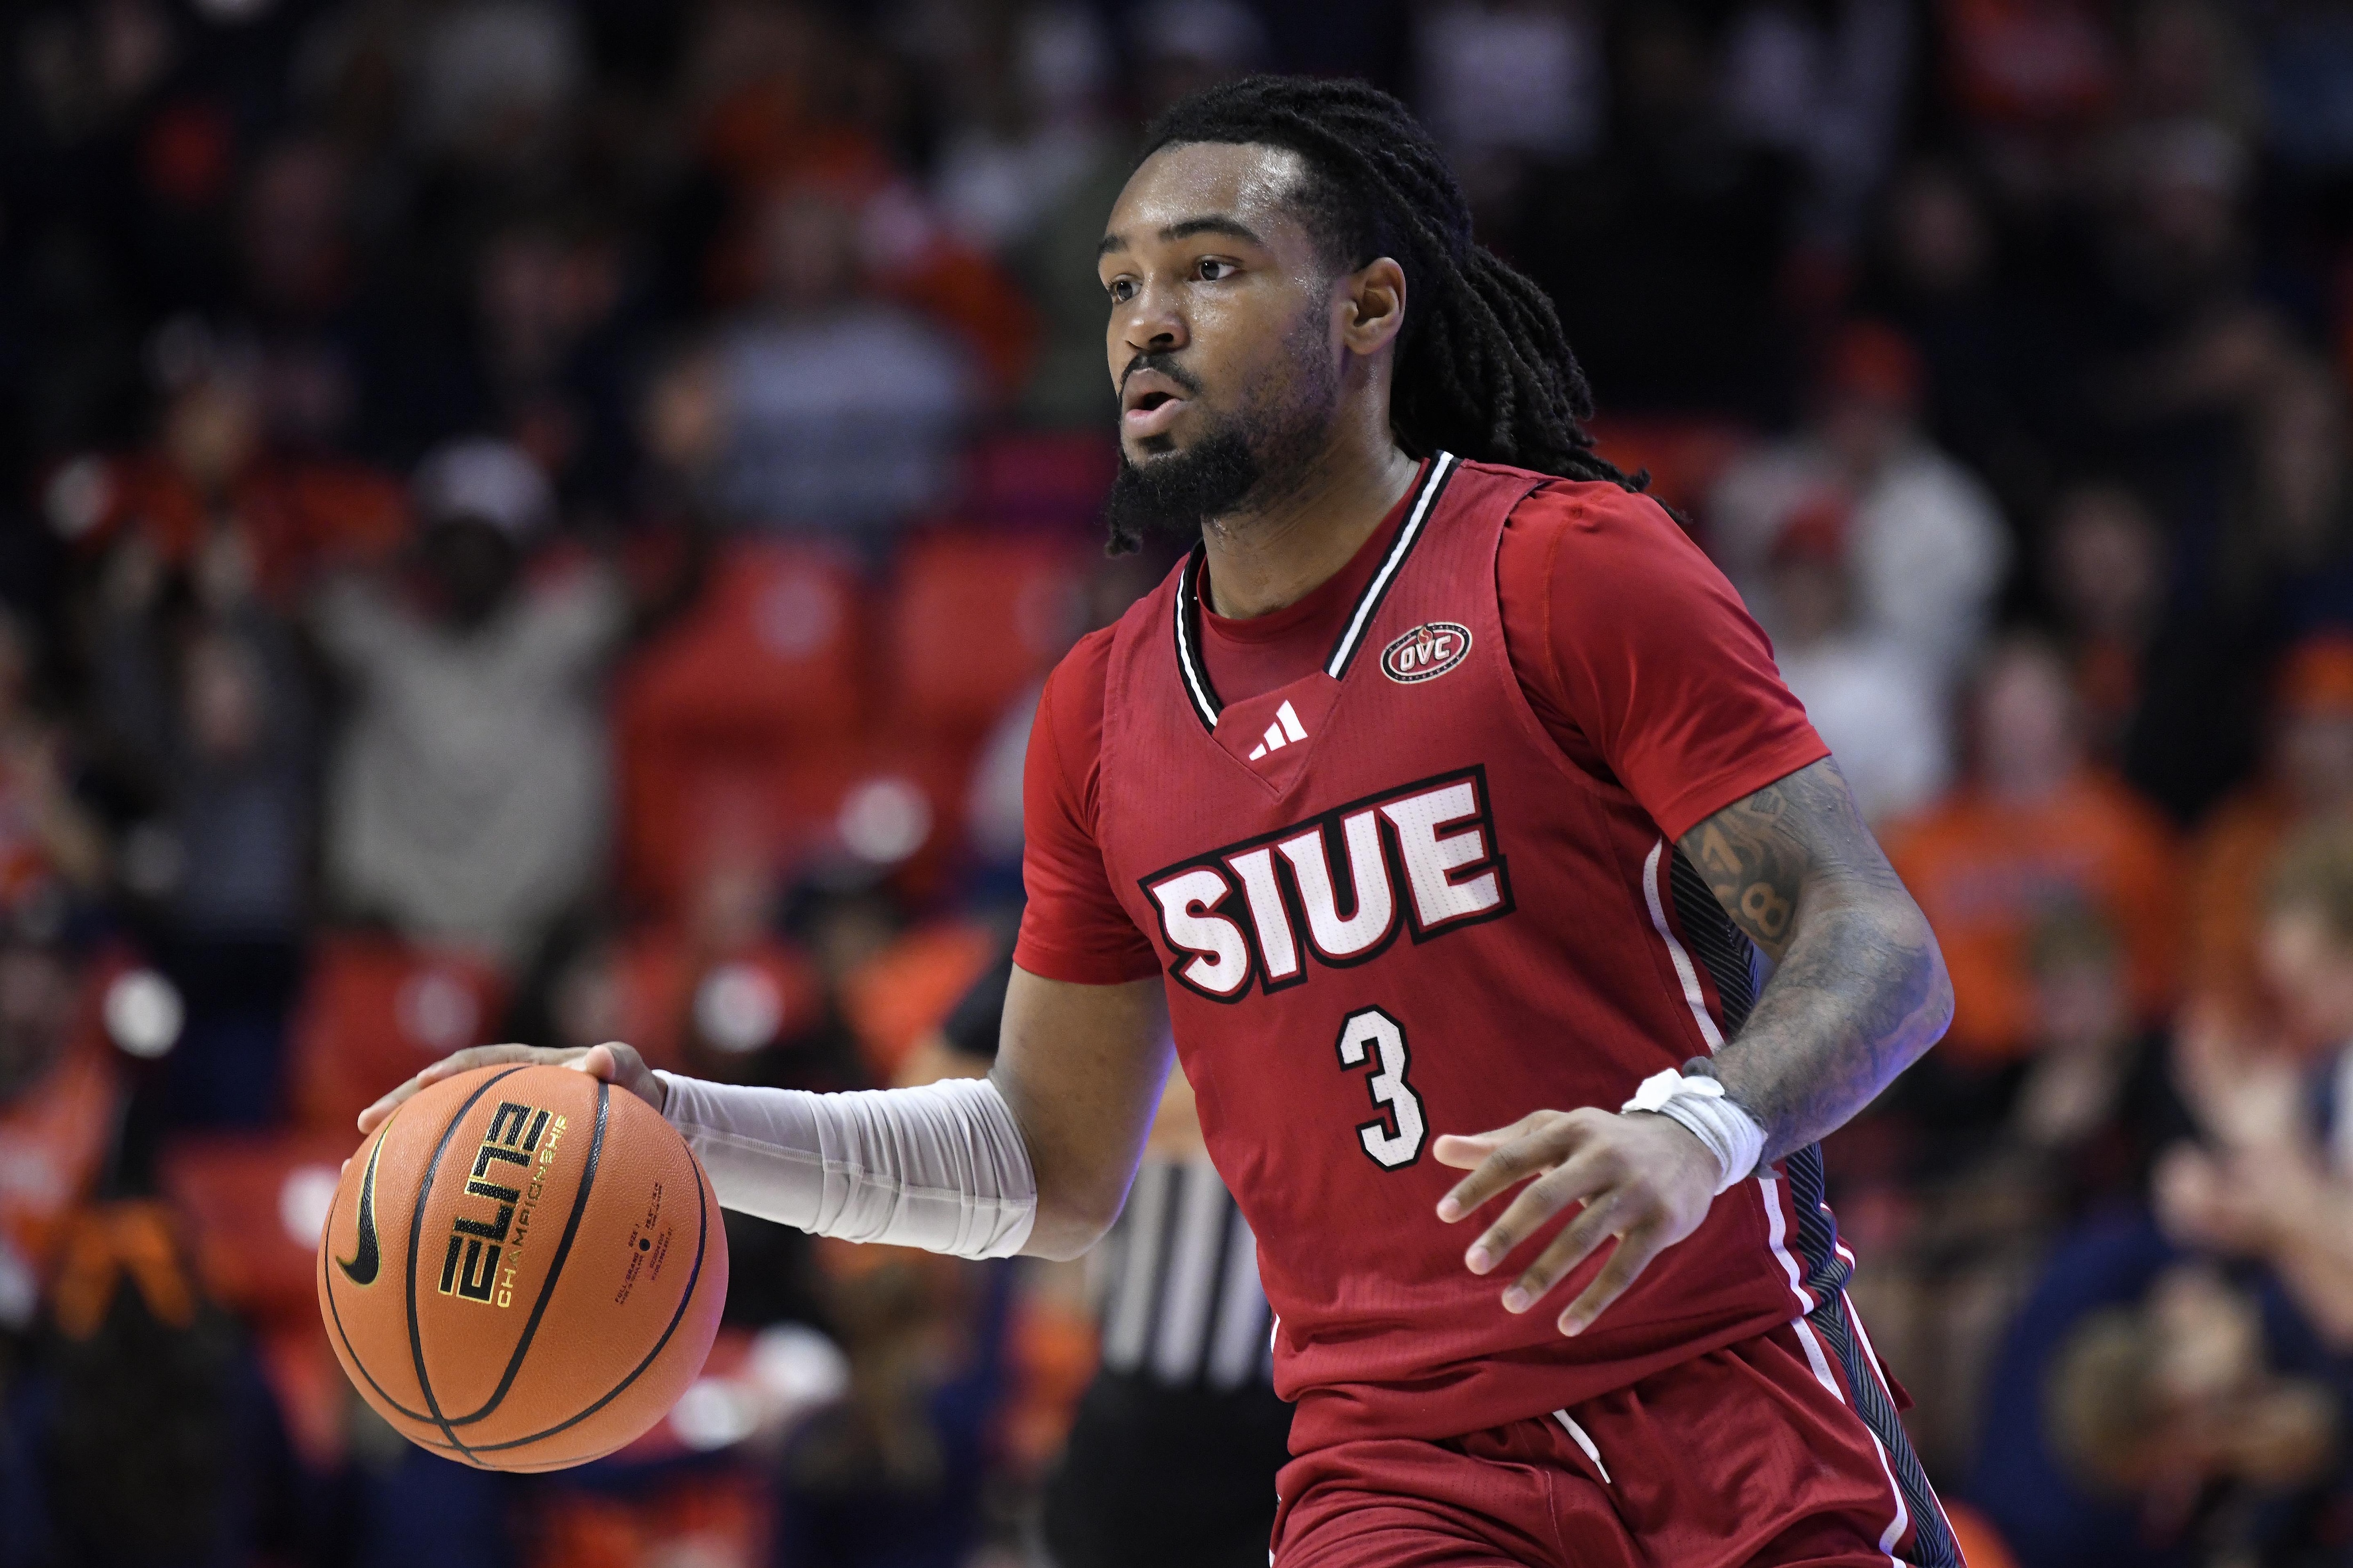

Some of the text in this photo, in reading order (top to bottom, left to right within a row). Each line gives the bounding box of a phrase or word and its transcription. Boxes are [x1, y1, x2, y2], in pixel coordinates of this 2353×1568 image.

[1400, 634, 1451, 671] OVC
[1137, 764, 1516, 1003] SIUE
[1336, 1004, 1430, 1172] 3
[438, 1100, 553, 1304] ELITE
[497, 1115, 567, 1308] CHAMPIONSHIP
[615, 1252, 639, 1303] FULL/GRAND
[628, 1230, 638, 1248] SIZE
